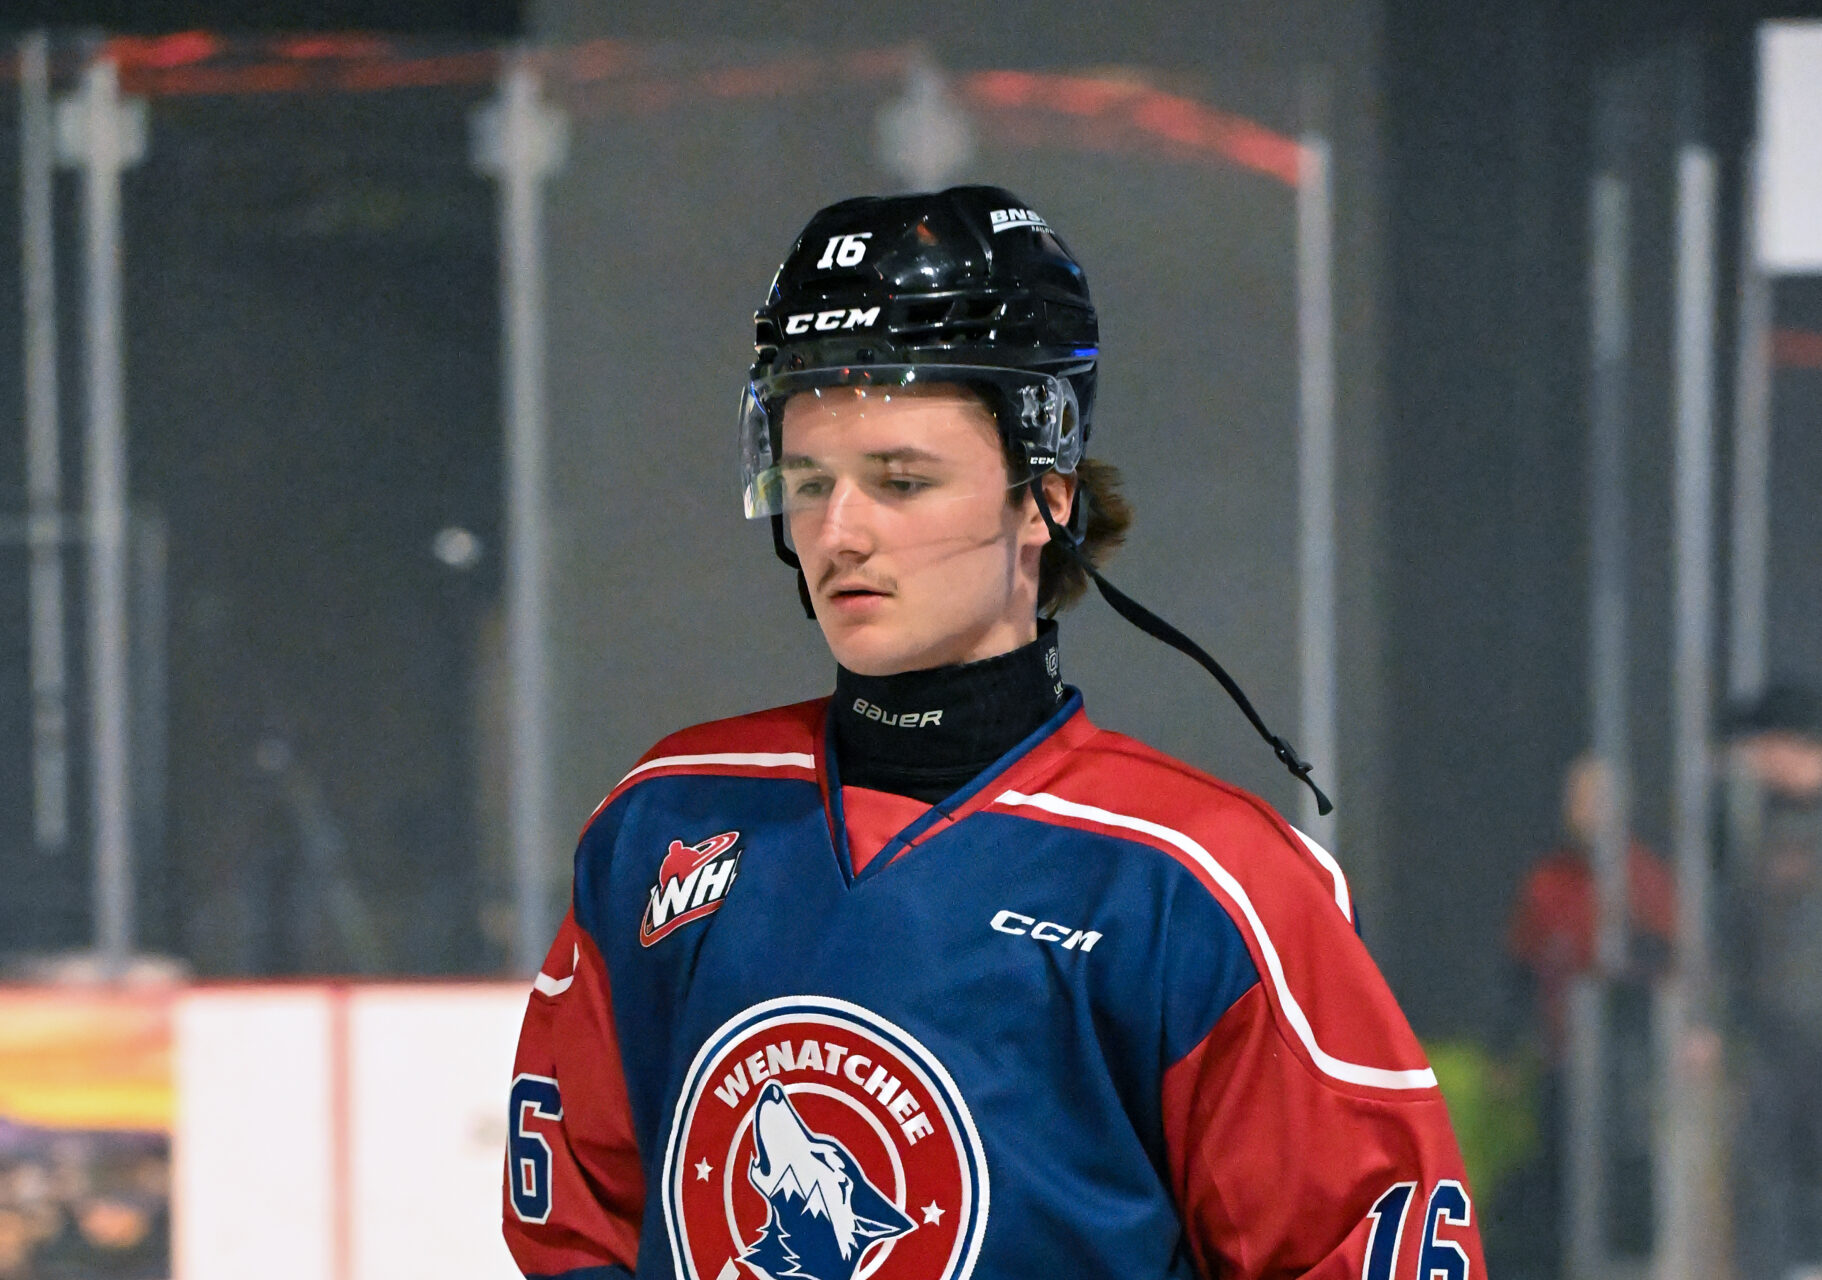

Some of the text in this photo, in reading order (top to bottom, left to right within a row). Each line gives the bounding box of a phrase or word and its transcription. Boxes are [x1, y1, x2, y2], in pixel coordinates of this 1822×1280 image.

[990, 208, 1047, 225] BNS
[817, 232, 873, 269] 16
[785, 306, 881, 335] CCM
[1029, 456, 1055, 466] CCM
[990, 910, 1103, 952] CCM
[714, 1039, 934, 1146] WENATCHEE
